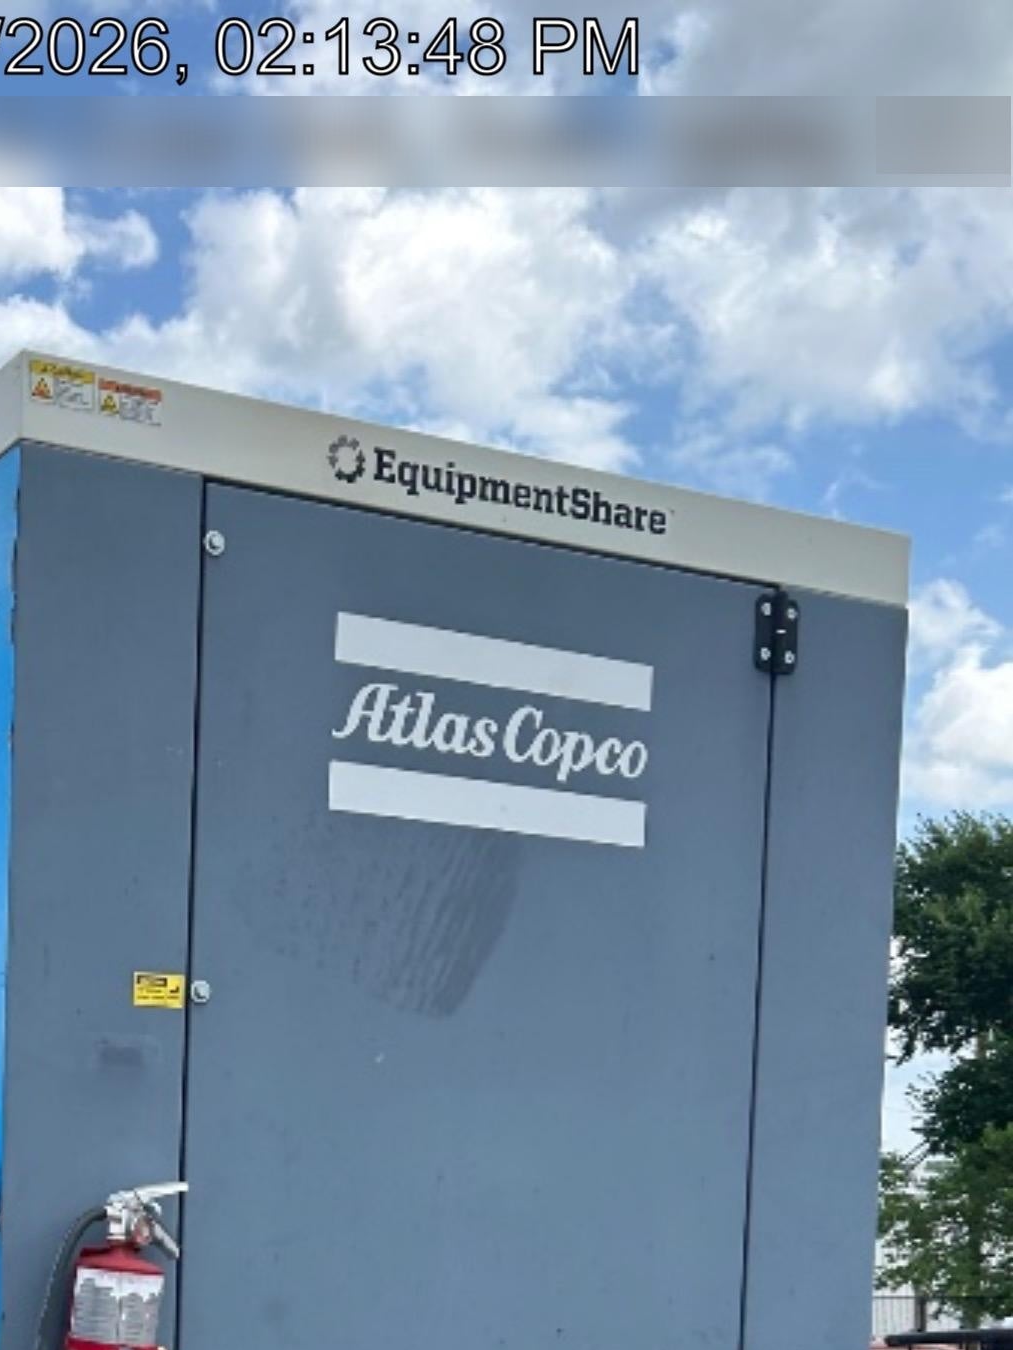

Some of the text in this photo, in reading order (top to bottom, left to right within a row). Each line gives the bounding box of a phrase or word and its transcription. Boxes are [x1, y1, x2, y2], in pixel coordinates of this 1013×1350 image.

[373, 447, 667, 534] EquipmentShare
[331, 682, 648, 782] Atlas Copco
